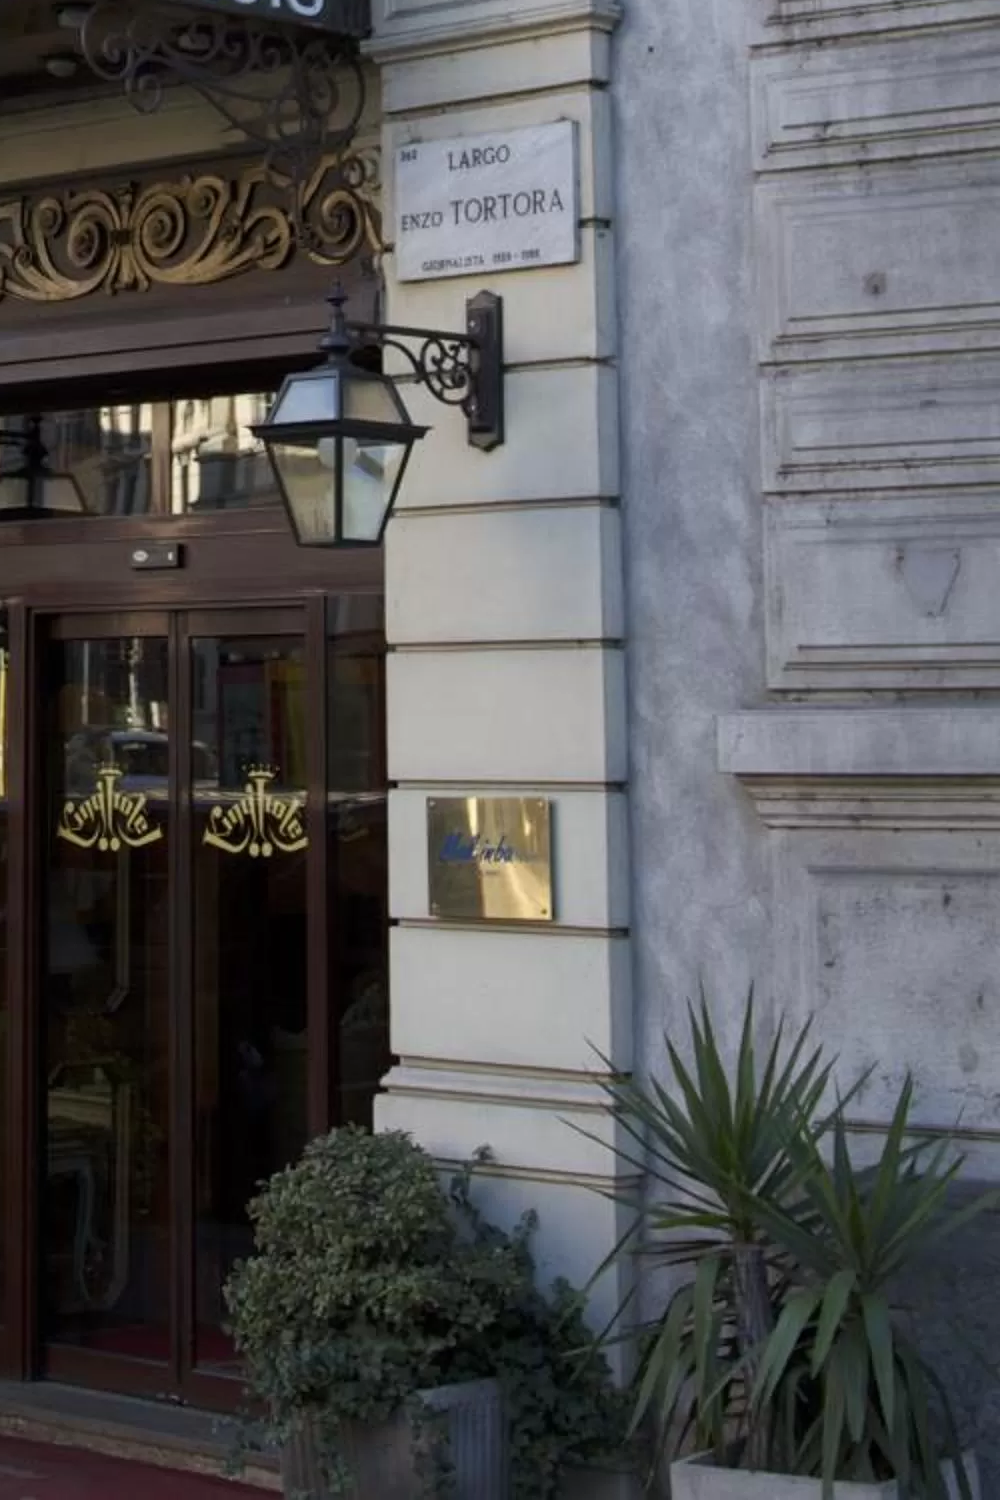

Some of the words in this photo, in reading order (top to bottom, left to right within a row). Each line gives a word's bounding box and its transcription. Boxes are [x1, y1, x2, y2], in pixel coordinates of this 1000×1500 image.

[448, 144, 511, 171] LARGO
[401, 211, 444, 231] ENZO
[450, 189, 564, 225] TORTORA
